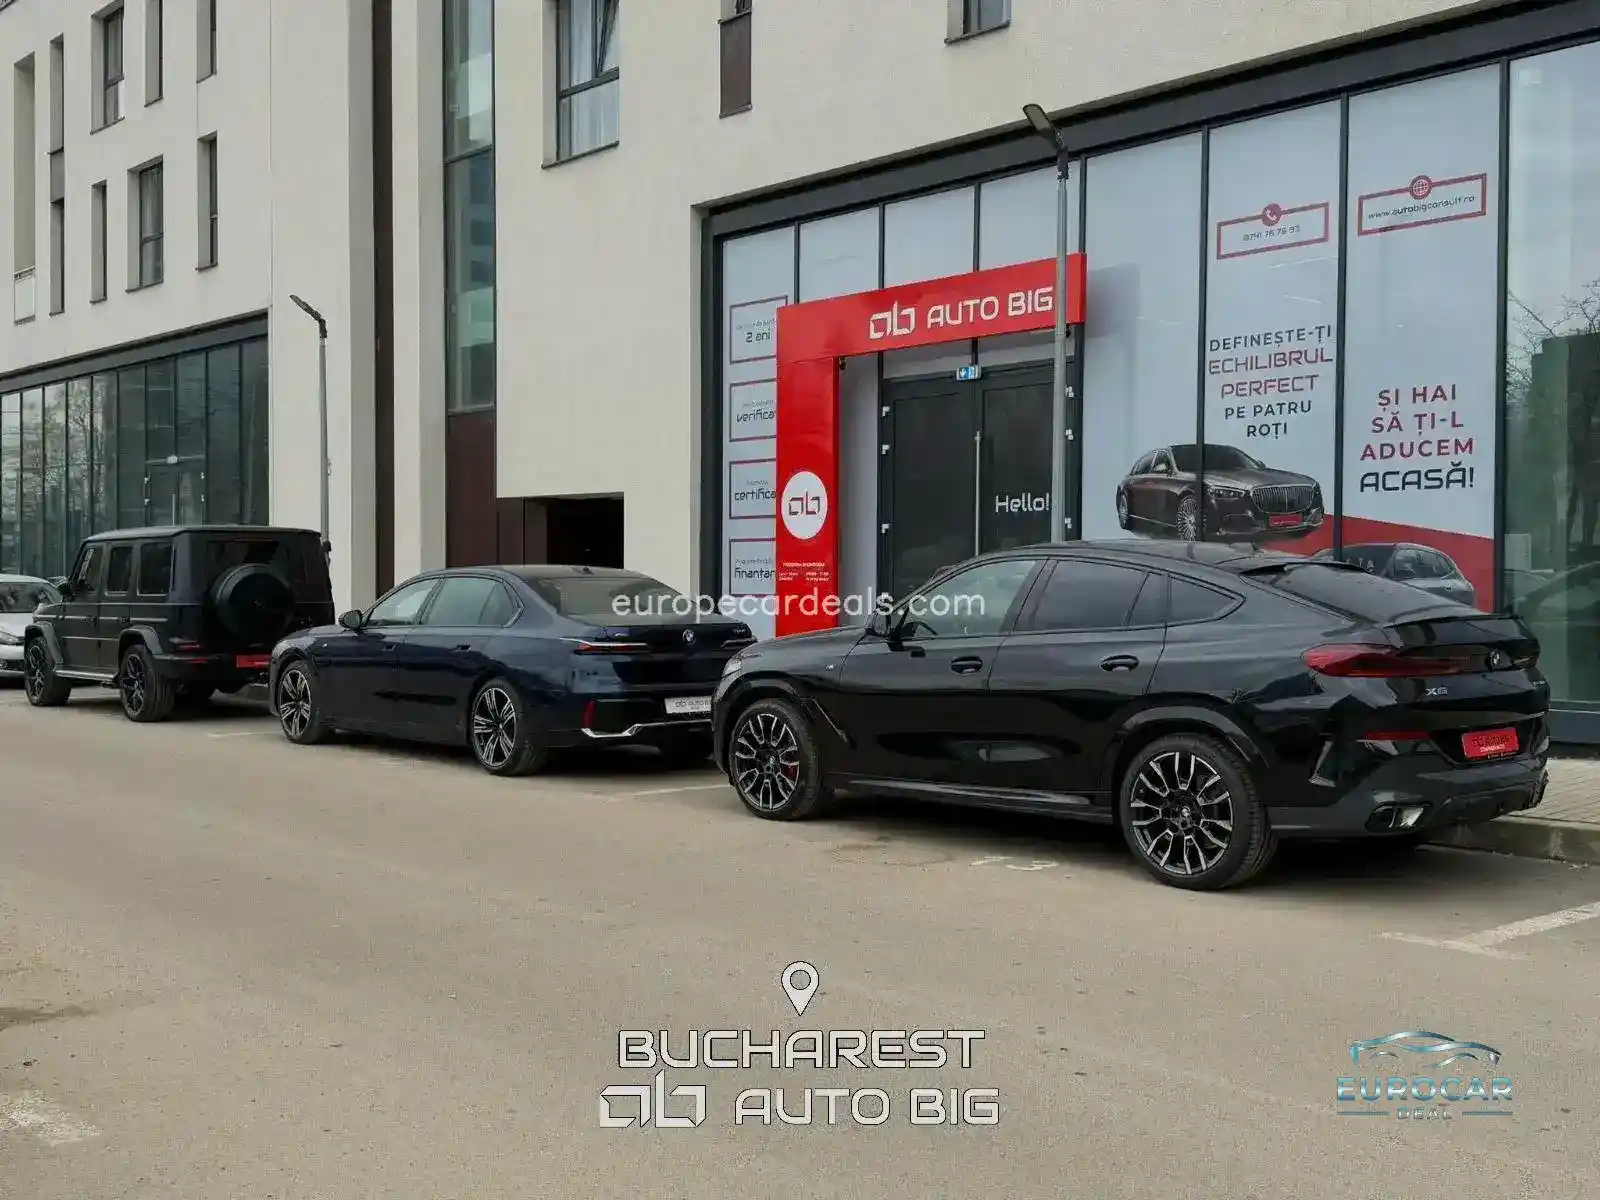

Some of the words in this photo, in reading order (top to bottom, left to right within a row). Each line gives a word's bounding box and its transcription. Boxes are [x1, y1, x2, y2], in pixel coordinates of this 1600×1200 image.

[927, 296, 999, 329] AUTO
[1007, 286, 1053, 317] BIG
[745, 332, 753, 343] 2
[755, 331, 771, 342] ani
[1209, 324, 1332, 352] DEFINEȘTE-ȚI
[1208, 347, 1334, 375] ECHILIBRUL
[1221, 374, 1319, 399] PERFECT
[1377, 388, 1400, 411] ȘI
[1411, 383, 1457, 405] HAI
[736, 409, 776, 422] verifica
[1224, 406, 1245, 420] PE
[1253, 400, 1312, 417] PATRU
[1246, 421, 1288, 439] ROȚI
[1371, 412, 1403, 434] SĂ
[1414, 411, 1464, 436] ȚI-L
[1359, 437, 1474, 461] ADUCEM
[1359, 461, 1475, 493] ACASĂ!
[995, 493, 1050, 513] Hello!
